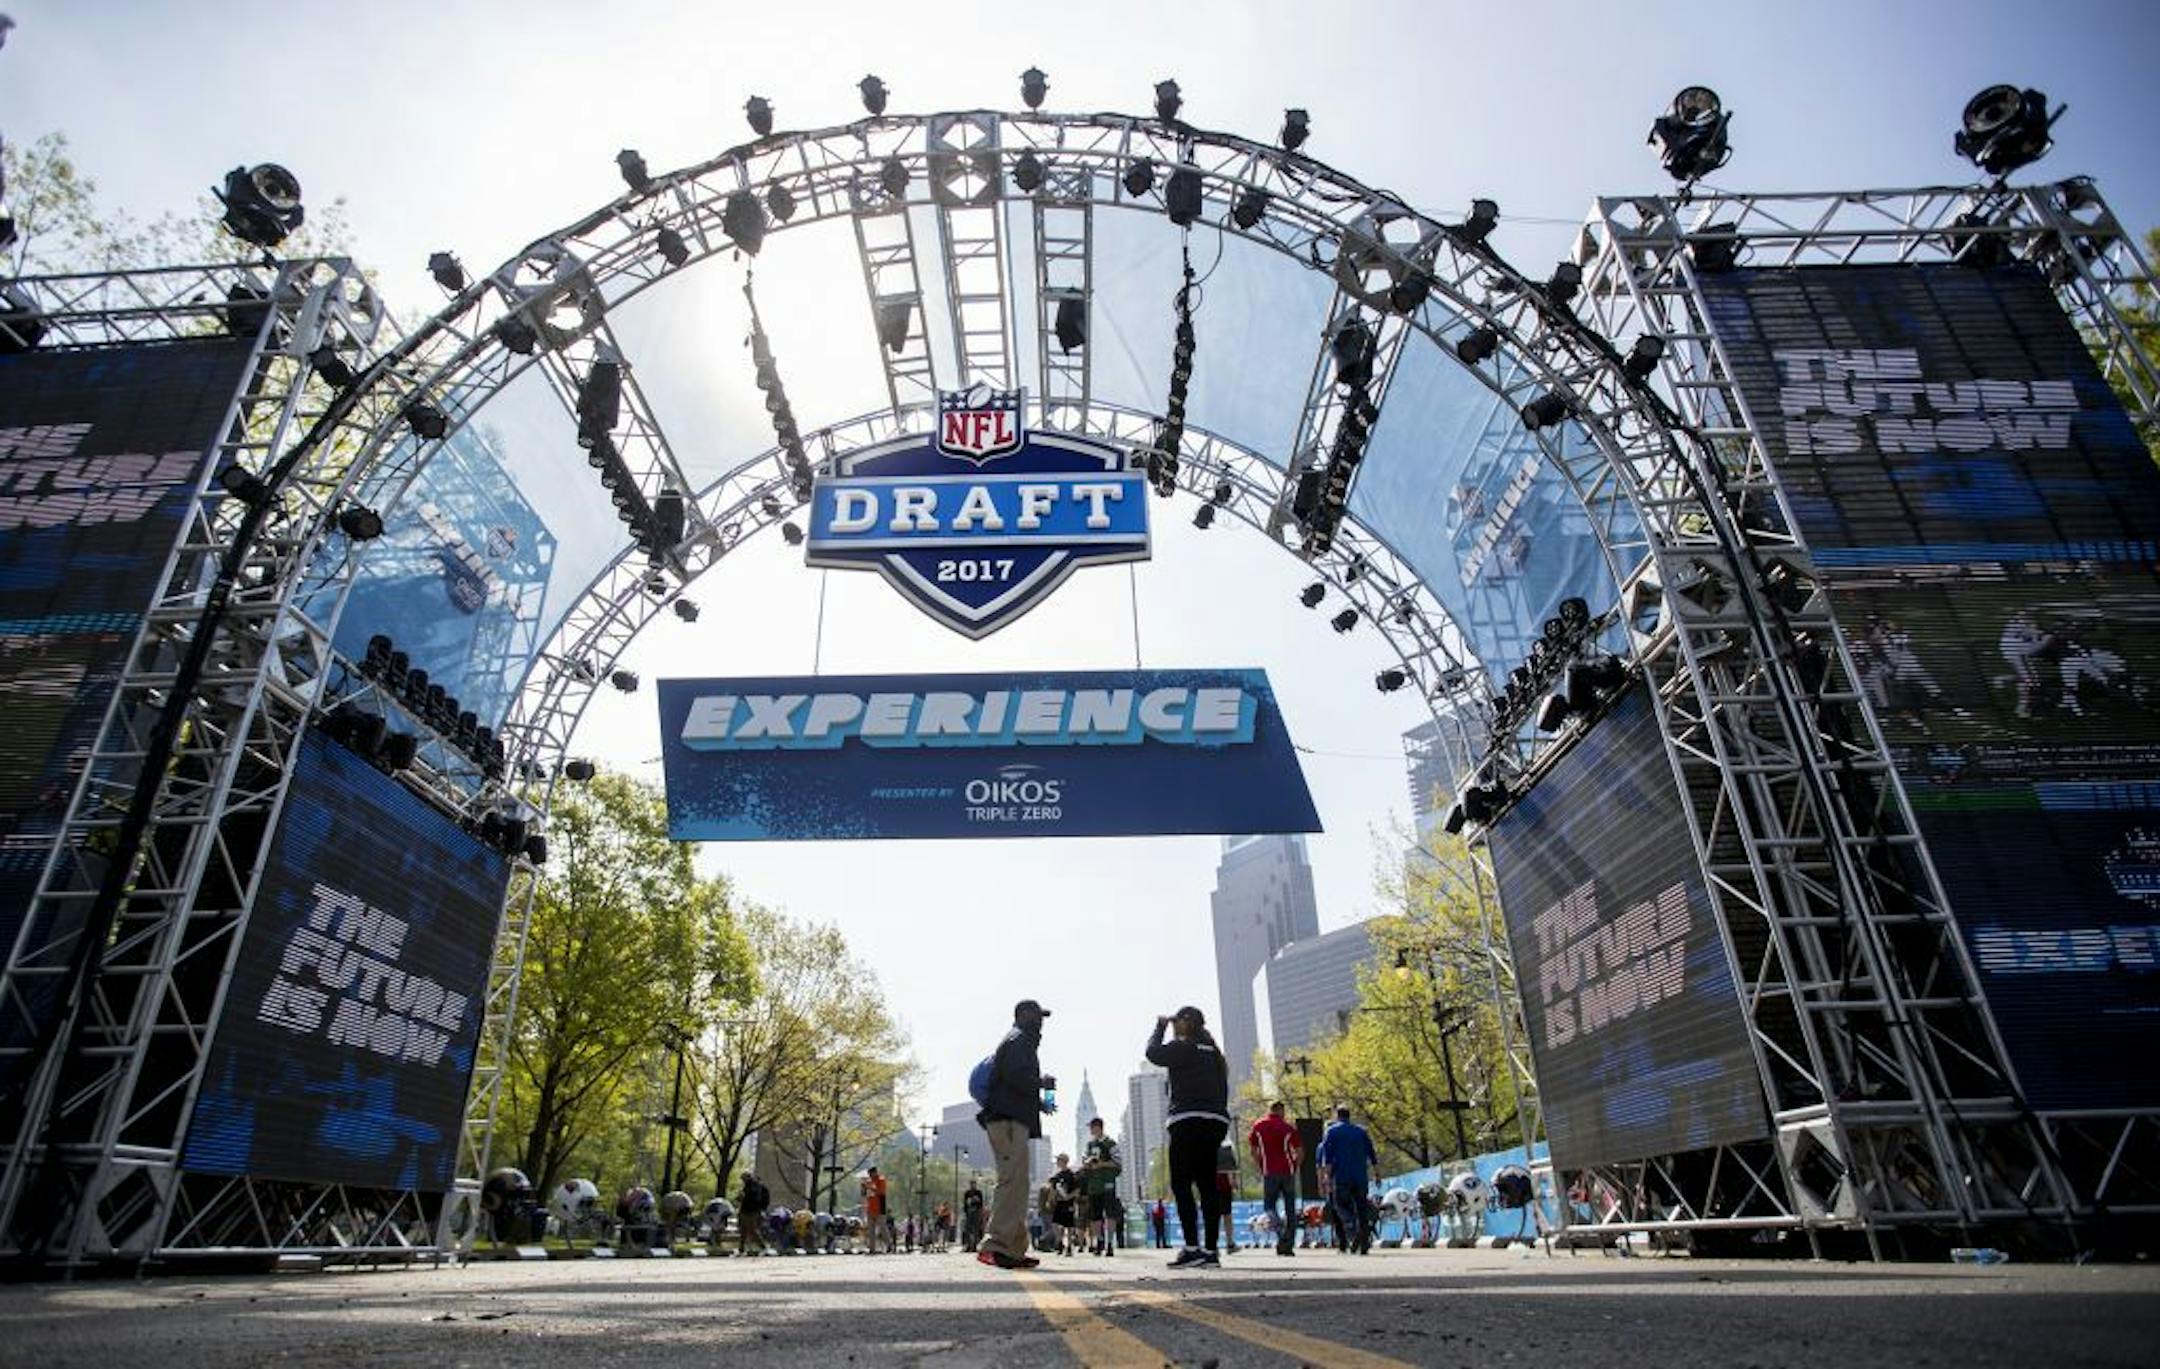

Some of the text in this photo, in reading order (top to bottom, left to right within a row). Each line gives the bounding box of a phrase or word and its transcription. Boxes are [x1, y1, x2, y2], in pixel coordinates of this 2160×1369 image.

[1773, 348, 1922, 380] THE
[1780, 380, 2080, 416] FUTURE
[0, 422, 94, 460] HE
[944, 410, 1013, 449] NFL
[1785, 414, 2071, 456] IS NOW
[828, 483, 1124, 533] DRAFT
[937, 558, 1015, 582] 2017
[682, 687, 1250, 747] EXPERIENCE
[871, 788, 954, 799] PRESENTED BY
[965, 779, 1061, 804] OIKOS
[965, 807, 1062, 821] TRIPLE ZERO
[308, 882, 409, 960] THE
[1533, 879, 1599, 957] THE
[1539, 881, 1692, 1003] FUTURE
[1974, 927, 2160, 973] EXPE
[281, 926, 468, 1032] FUTURE
[1544, 940, 1686, 1050] IS NOW
[256, 975, 450, 1068] IS NOW
